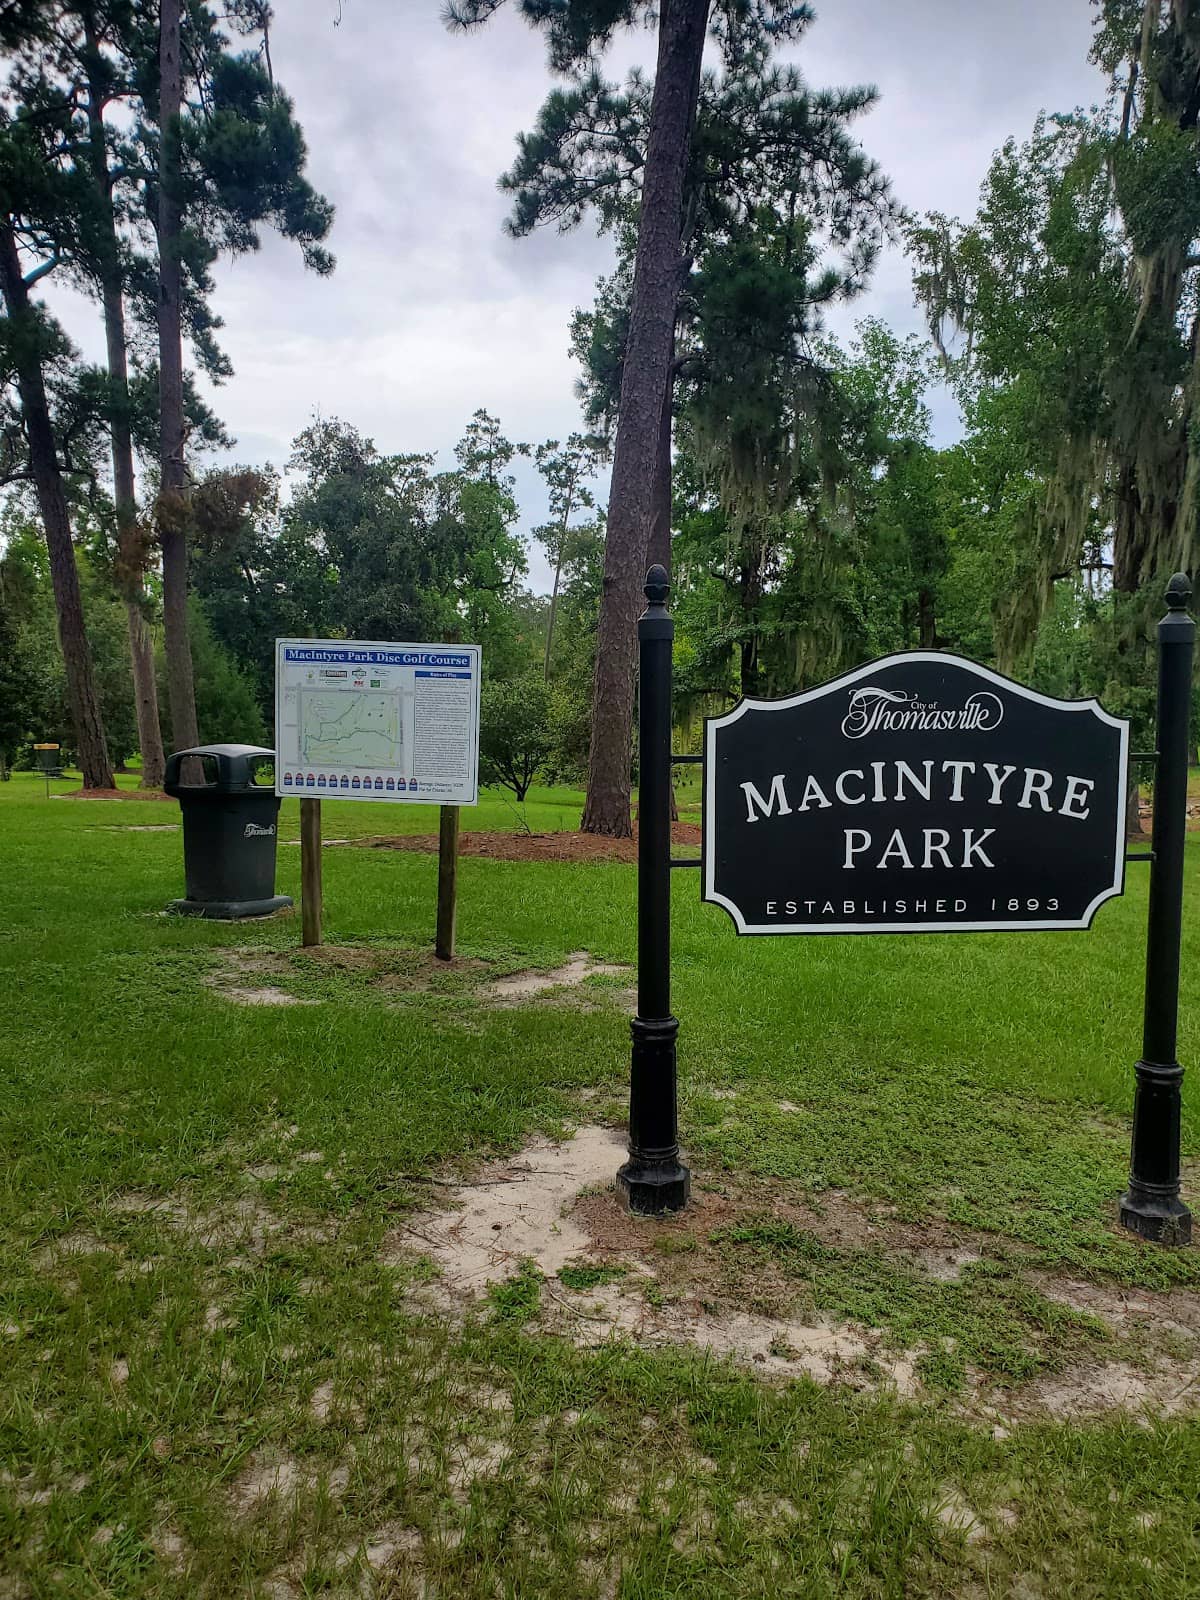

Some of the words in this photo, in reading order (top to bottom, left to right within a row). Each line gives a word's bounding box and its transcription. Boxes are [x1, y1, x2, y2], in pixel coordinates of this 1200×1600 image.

[288, 650, 345, 662] MacIntyre
[347, 652, 373, 662] Park
[376, 653, 401, 663] Disc
[403, 654, 427, 664] Golf
[428, 655, 468, 665] Course
[841, 687, 1004, 739] Thomasville
[910, 701, 927, 712] City
[928, 701, 938, 710] of
[740, 760, 1095, 823] MACINTYRE
[842, 828, 997, 869] PARK
[766, 900, 967, 915] ESTABLISHED
[991, 898, 1060, 911] 1893
